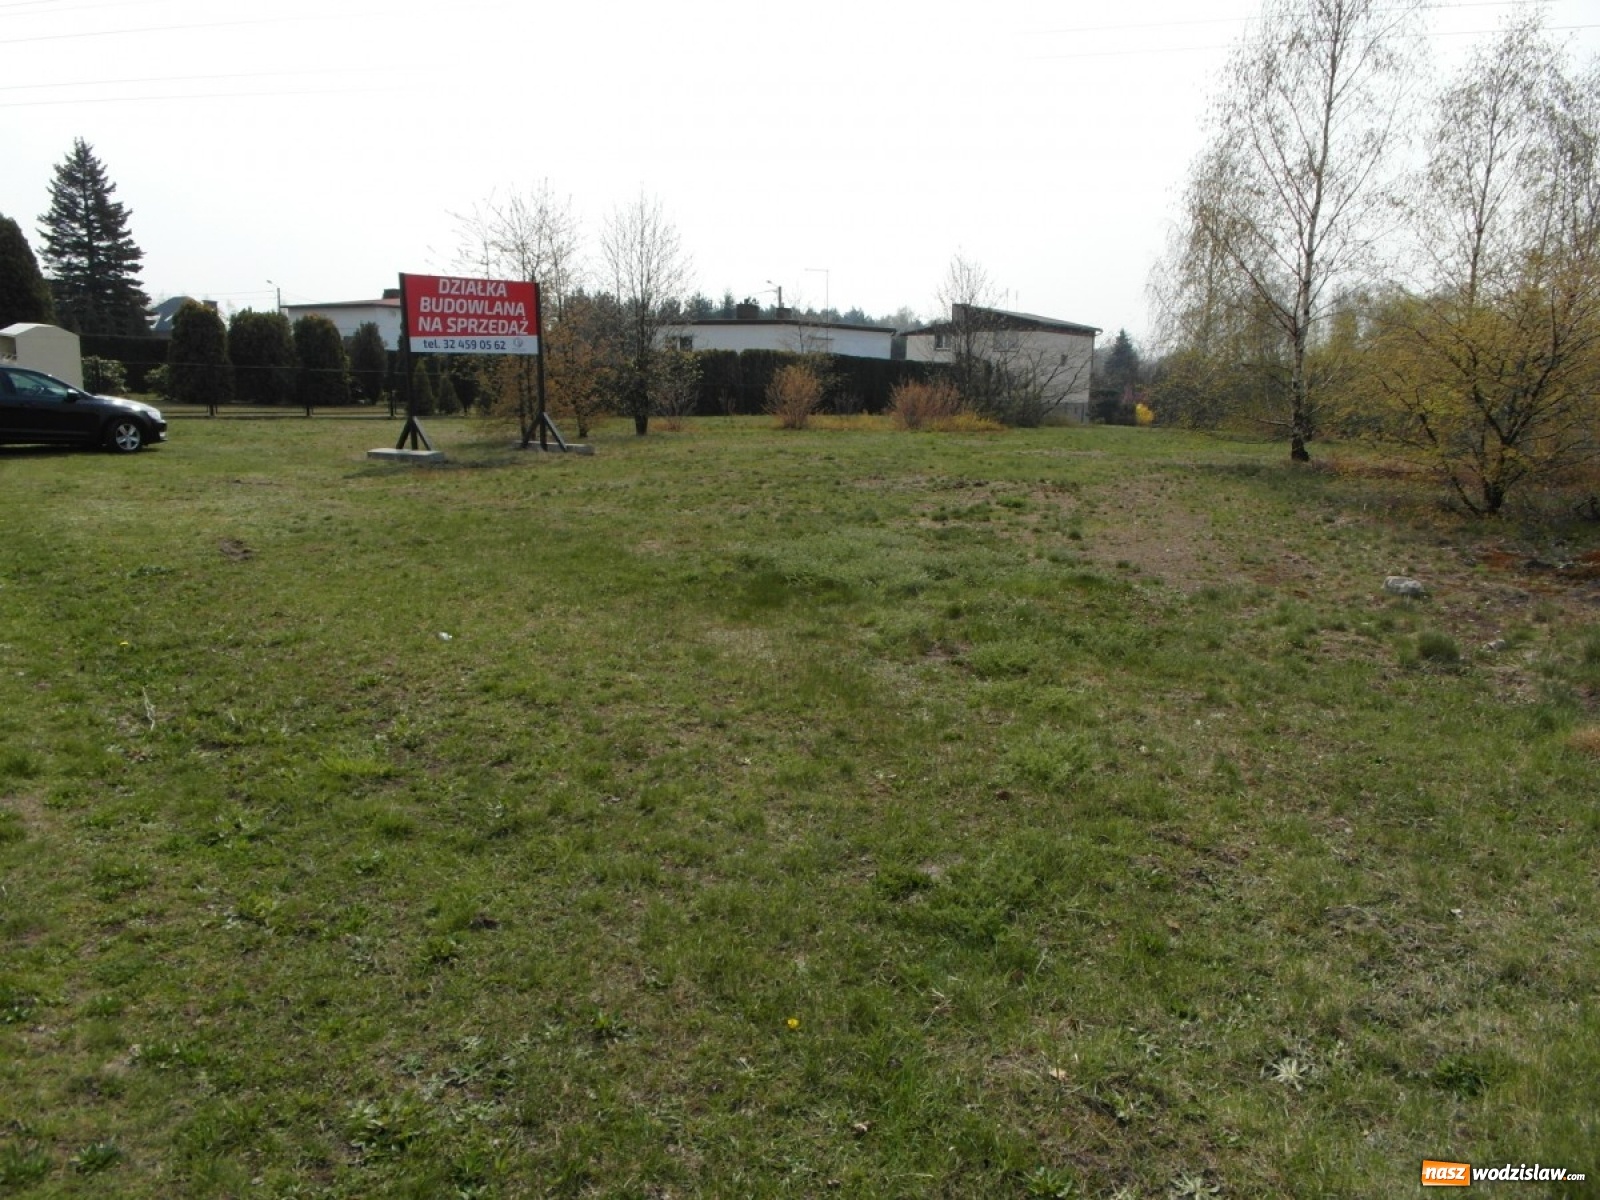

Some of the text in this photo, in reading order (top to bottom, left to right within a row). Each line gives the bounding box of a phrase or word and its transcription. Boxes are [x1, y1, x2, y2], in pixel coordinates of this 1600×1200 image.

[438, 278, 507, 297] DZIAŁKA
[420, 296, 526, 316] BUDOWLANA
[418, 316, 529, 335] NA SPRZEDAŻ
[423, 339, 439, 349] tel.
[443, 340, 456, 349] 32
[458, 340, 477, 350] 459
[480, 340, 492, 350] 05
[494, 340, 506, 350] 62
